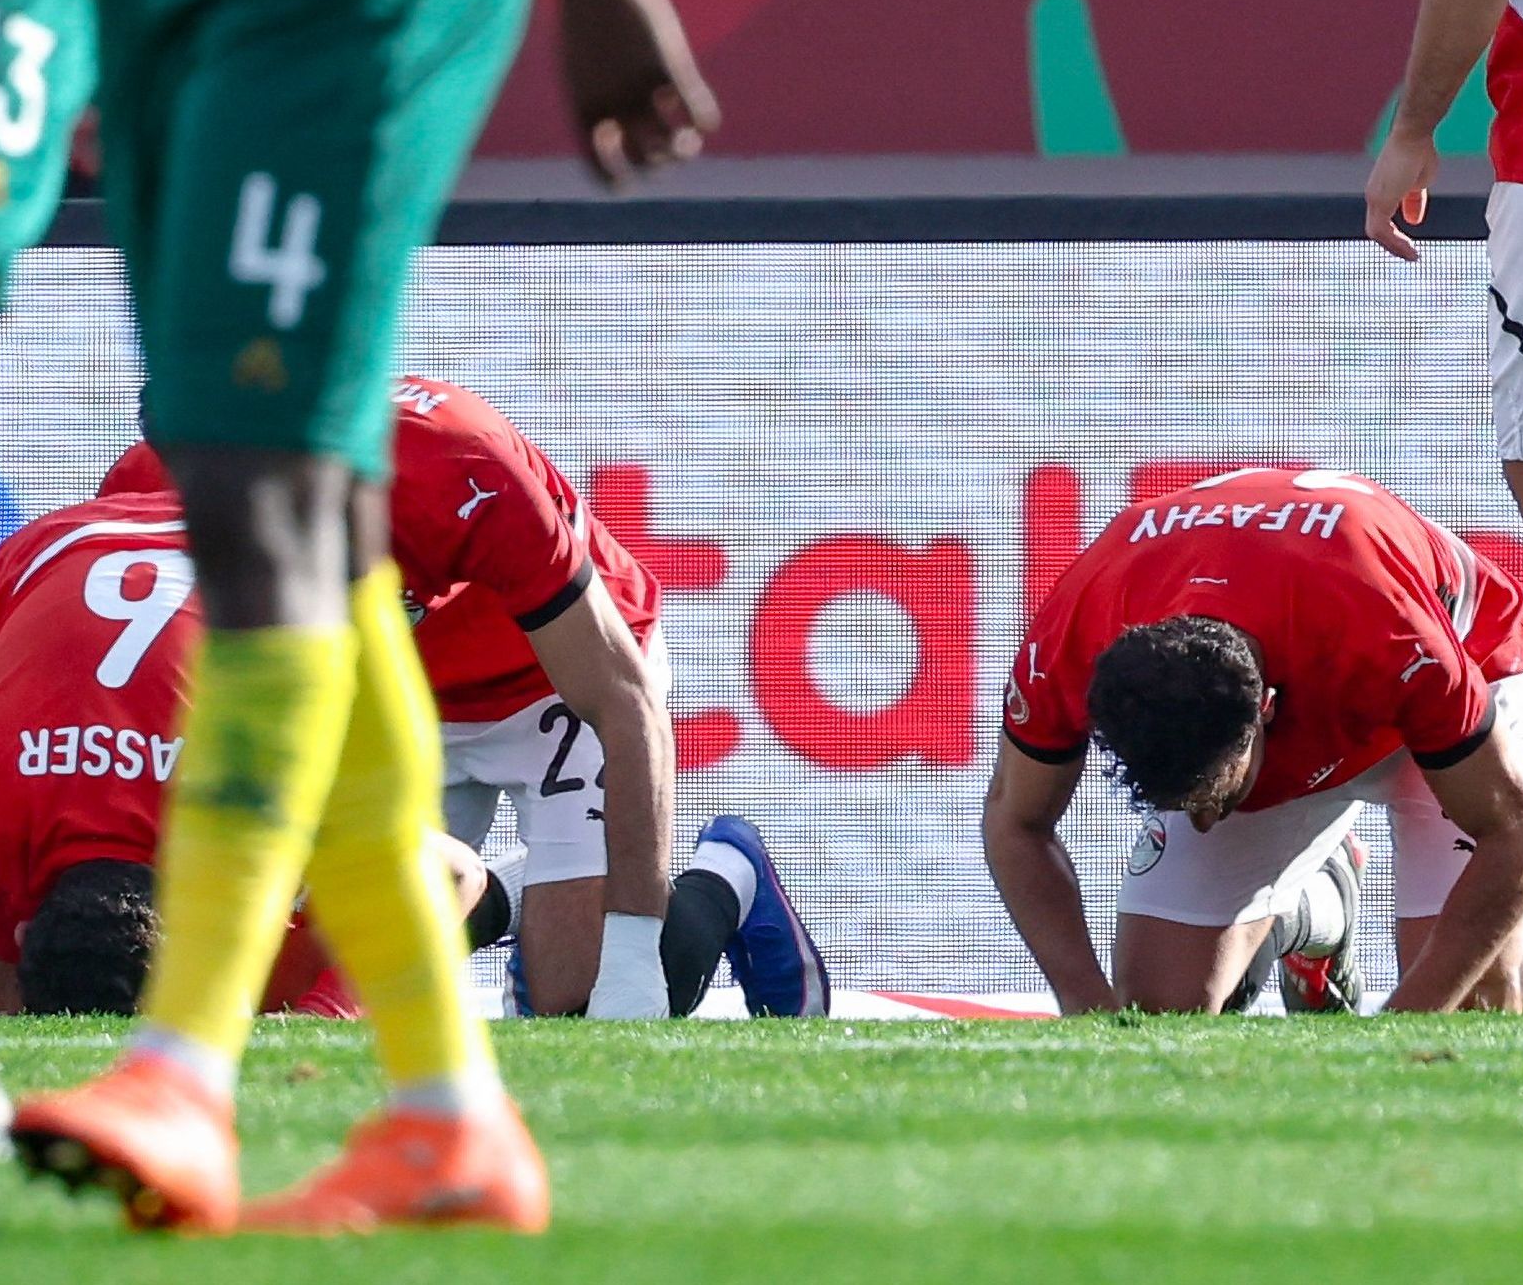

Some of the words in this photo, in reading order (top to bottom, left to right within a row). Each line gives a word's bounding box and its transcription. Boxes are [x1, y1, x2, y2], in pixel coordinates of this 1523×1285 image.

[229, 171, 325, 329] 4
[1128, 501, 1346, 543] H.FATHY
[83, 549, 197, 689] 6
[17, 724, 186, 782] ASSER
